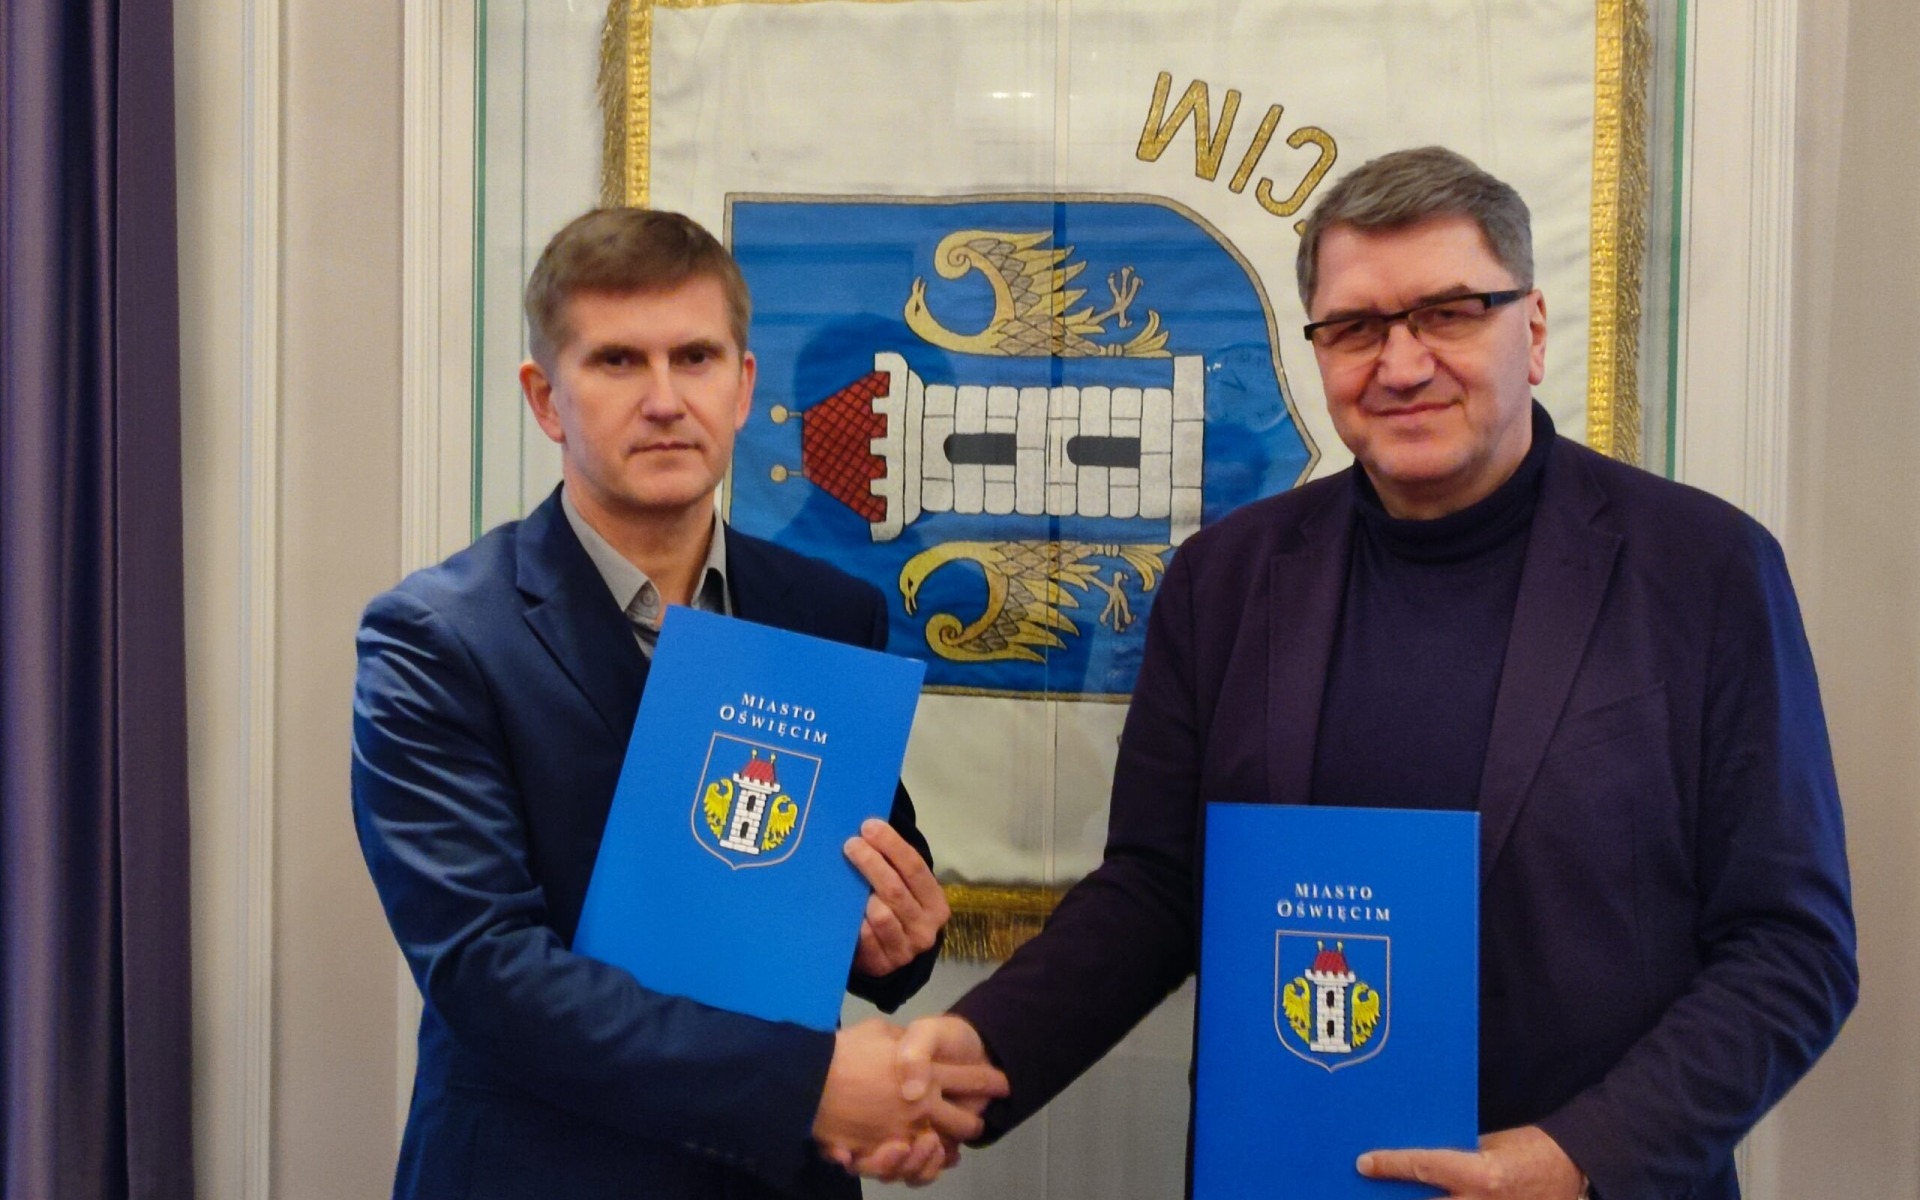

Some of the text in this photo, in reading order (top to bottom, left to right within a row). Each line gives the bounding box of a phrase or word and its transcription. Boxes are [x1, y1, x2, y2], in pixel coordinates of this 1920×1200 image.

[1136, 71, 1338, 237] CIM
[741, 692, 816, 722] MIASTO
[719, 705, 828, 745] OŚWIĘCIM
[1295, 882, 1373, 901] MIASTO
[1276, 898, 1390, 923] OŚWIĘCIM
